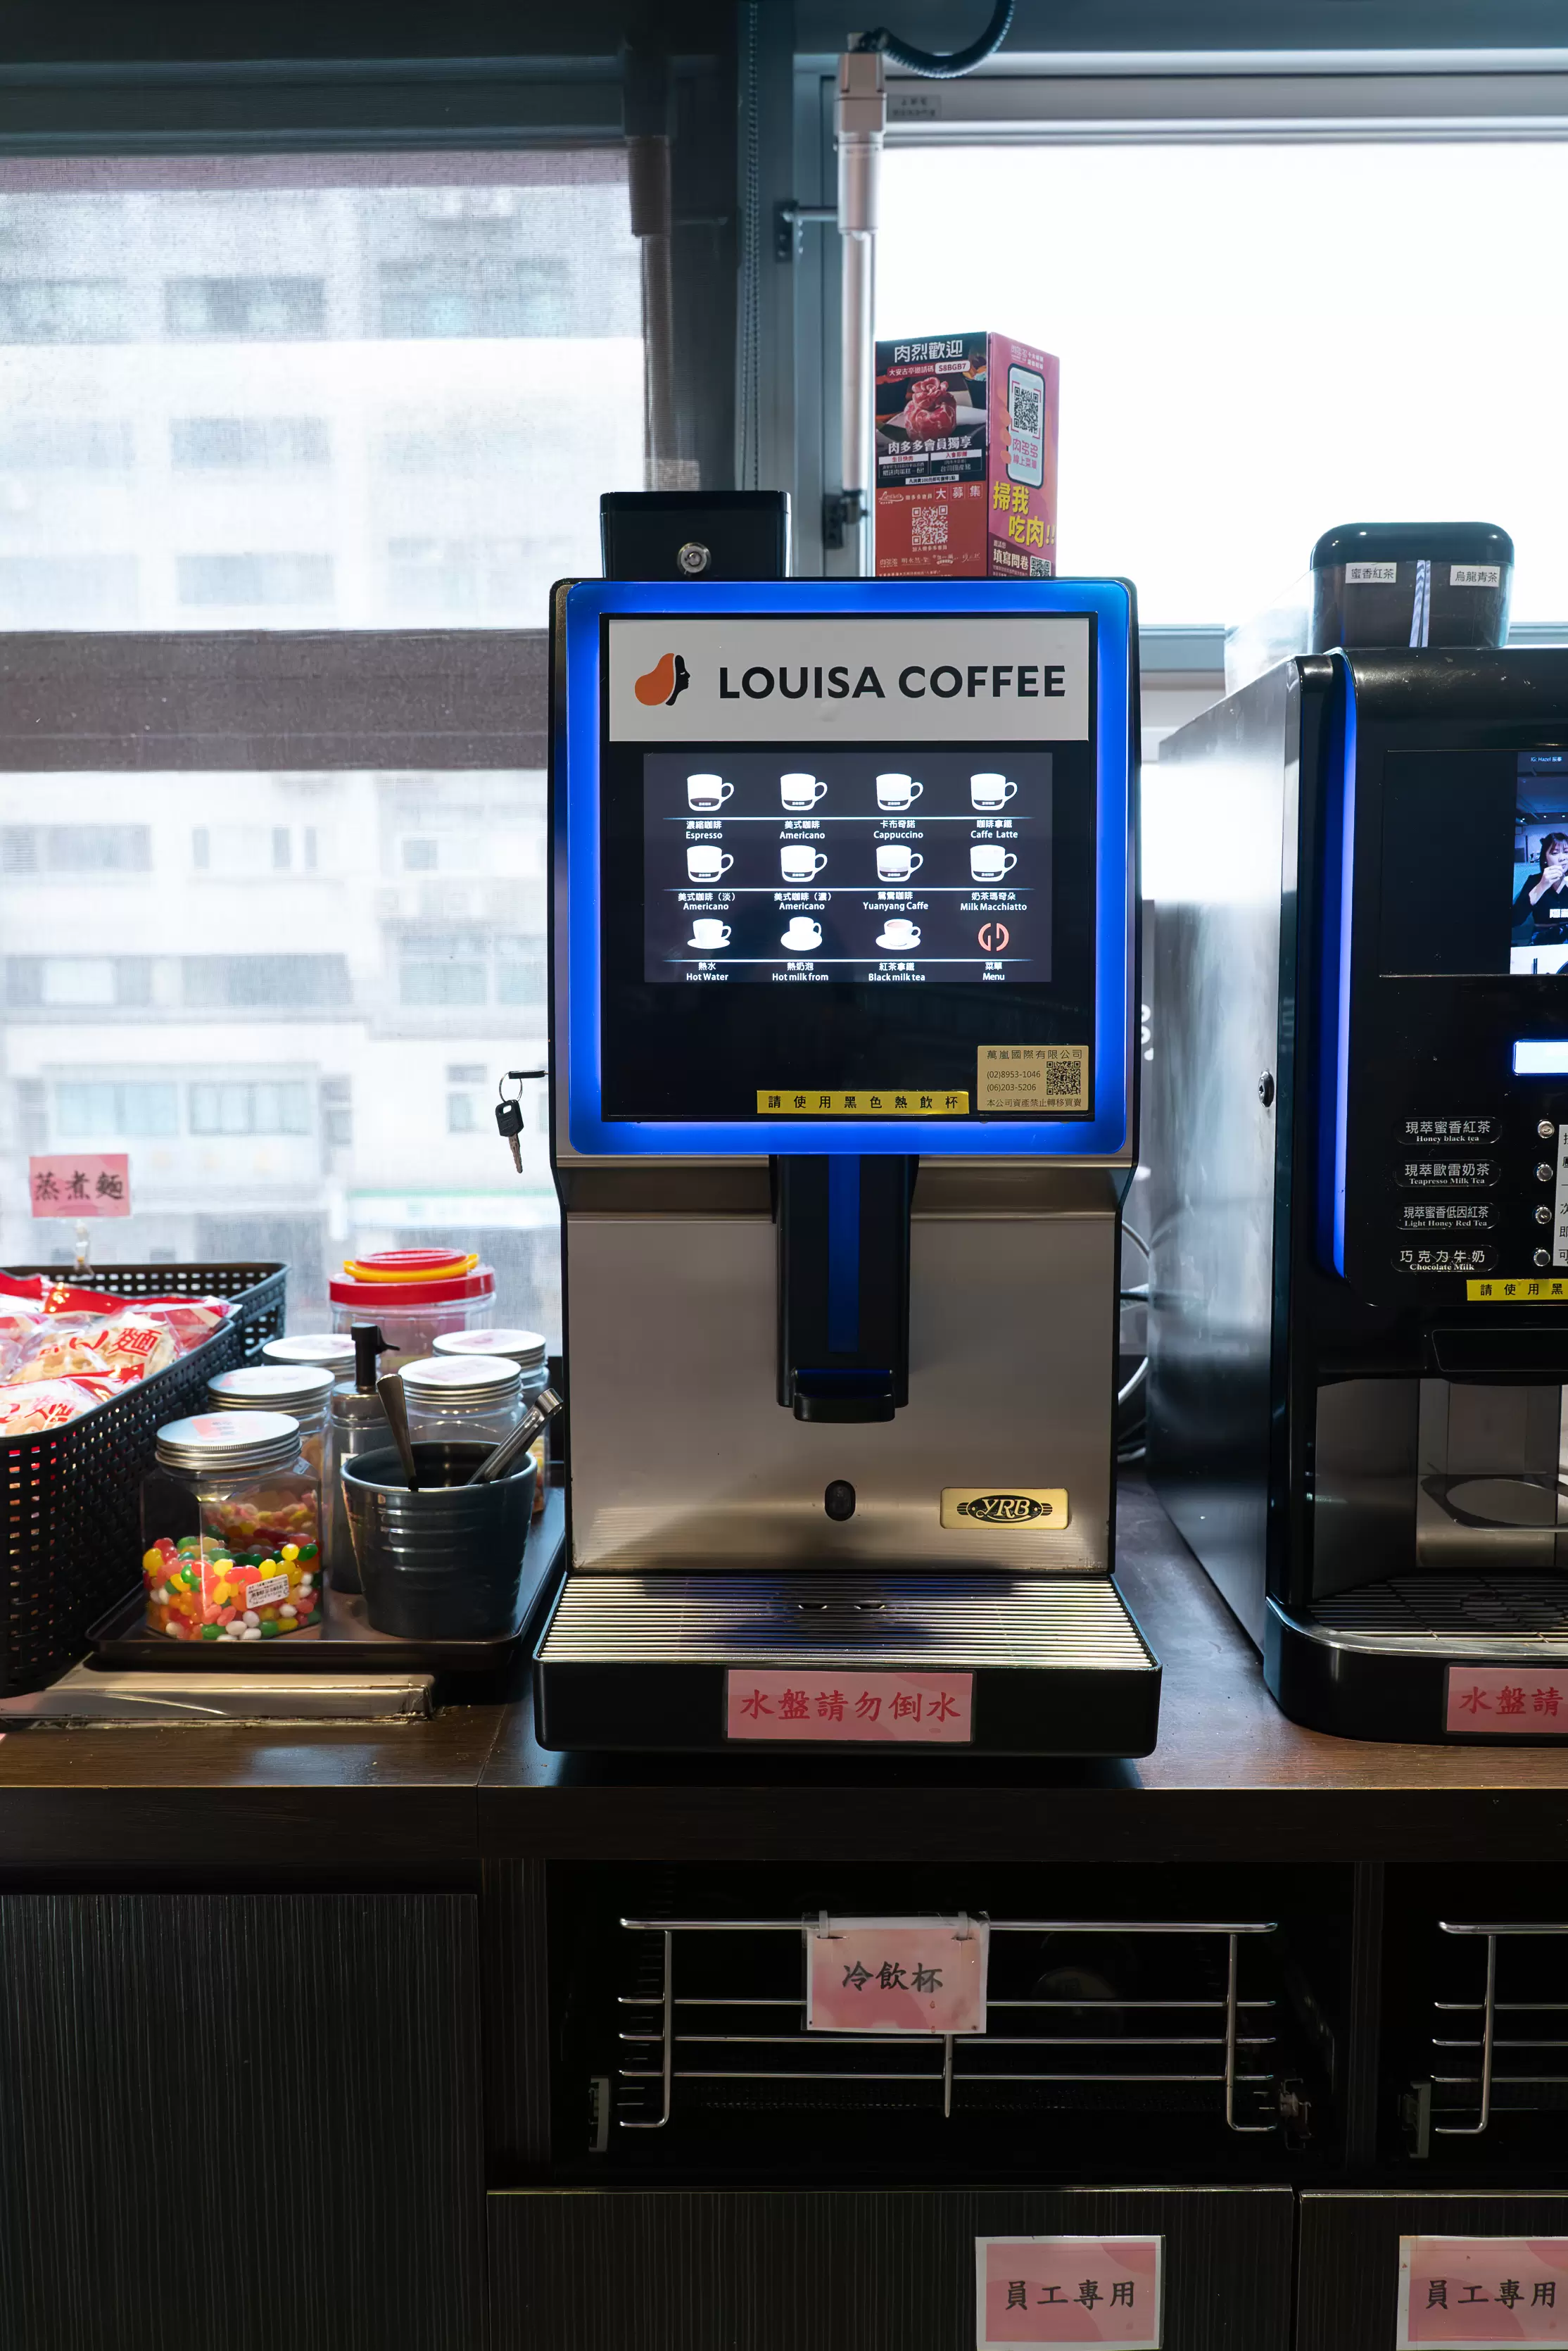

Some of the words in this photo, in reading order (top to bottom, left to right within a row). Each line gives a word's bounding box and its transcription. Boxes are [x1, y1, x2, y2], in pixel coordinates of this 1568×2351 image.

[894, 339, 963, 363] 肉烈歡迎
[939, 363, 966, 372] S8BGB7
[888, 436, 972, 455] 肉多多會員獨享
[993, 481, 1030, 515] 掃我
[1009, 515, 1056, 548] 吃肉!!
[993, 548, 1029, 570] 填寫問卷
[1351, 567, 1394, 580] 蜜香紅茶
[1455, 570, 1498, 583] 烏龍青茶
[720, 667, 885, 699] LOUISA
[899, 666, 1065, 698] COFFEE
[686, 820, 722, 830] 濃縮咖啡
[784, 820, 820, 830] 美式咖啡
[880, 819, 916, 829] 卡布奇諾
[685, 831, 723, 840] Espresso
[780, 831, 826, 840] Americano
[873, 830, 923, 840] Cappuccino
[970, 830, 992, 840] Caffe
[996, 830, 1018, 840] Latte
[971, 892, 1016, 902] 奶茶瑪奇朵
[683, 902, 729, 911] Americano
[779, 902, 825, 911] Americano
[863, 902, 905, 912] Yuanyang
[906, 902, 928, 911] Caffe
[961, 902, 978, 911] Milk
[980, 902, 1028, 911] Macchiatto
[698, 962, 716, 971] 熱水
[879, 962, 915, 971] 紅茶拿鐵
[985, 962, 1002, 971] 菜單
[686, 973, 700, 981] Hot
[702, 973, 728, 981] Water
[772, 973, 787, 981] Hot
[789, 973, 807, 981] milk
[809, 973, 828, 981] from
[868, 973, 890, 981] Black
[892, 973, 911, 981] milk
[913, 973, 925, 981] tea
[982, 973, 1005, 981] Menu
[987, 1050, 1082, 1059] 萬嵐國際有限公司
[987, 1071, 1040, 1079] (02)8953-1046
[769, 1095, 958, 1109] 請使用黑色熱飲杯
[987, 1098, 1081, 1107] 本公司資產禁止轉移買賣
[1405, 1121, 1491, 1134] 現萃蜜香紅茶
[1405, 1164, 1490, 1177] 現萃歐雷奶茶
[34, 1171, 124, 1202] 蒸煮麵
[1404, 1206, 1488, 1219] 現萃蜜香低因紅茶
[1401, 1250, 1485, 1263] 巧克力牛奶
[1481, 1284, 1562, 1295] 請使用黑
[976, 1499, 1030, 1520] YRB
[740, 1689, 961, 1722] 水盤請勿倒水
[1459, 1686, 1563, 1717] 水盤請
[842, 1960, 943, 1993] 冷飲杯
[1006, 2280, 1134, 2310] 員工專用
[1426, 2279, 1555, 2309] 員工專用
